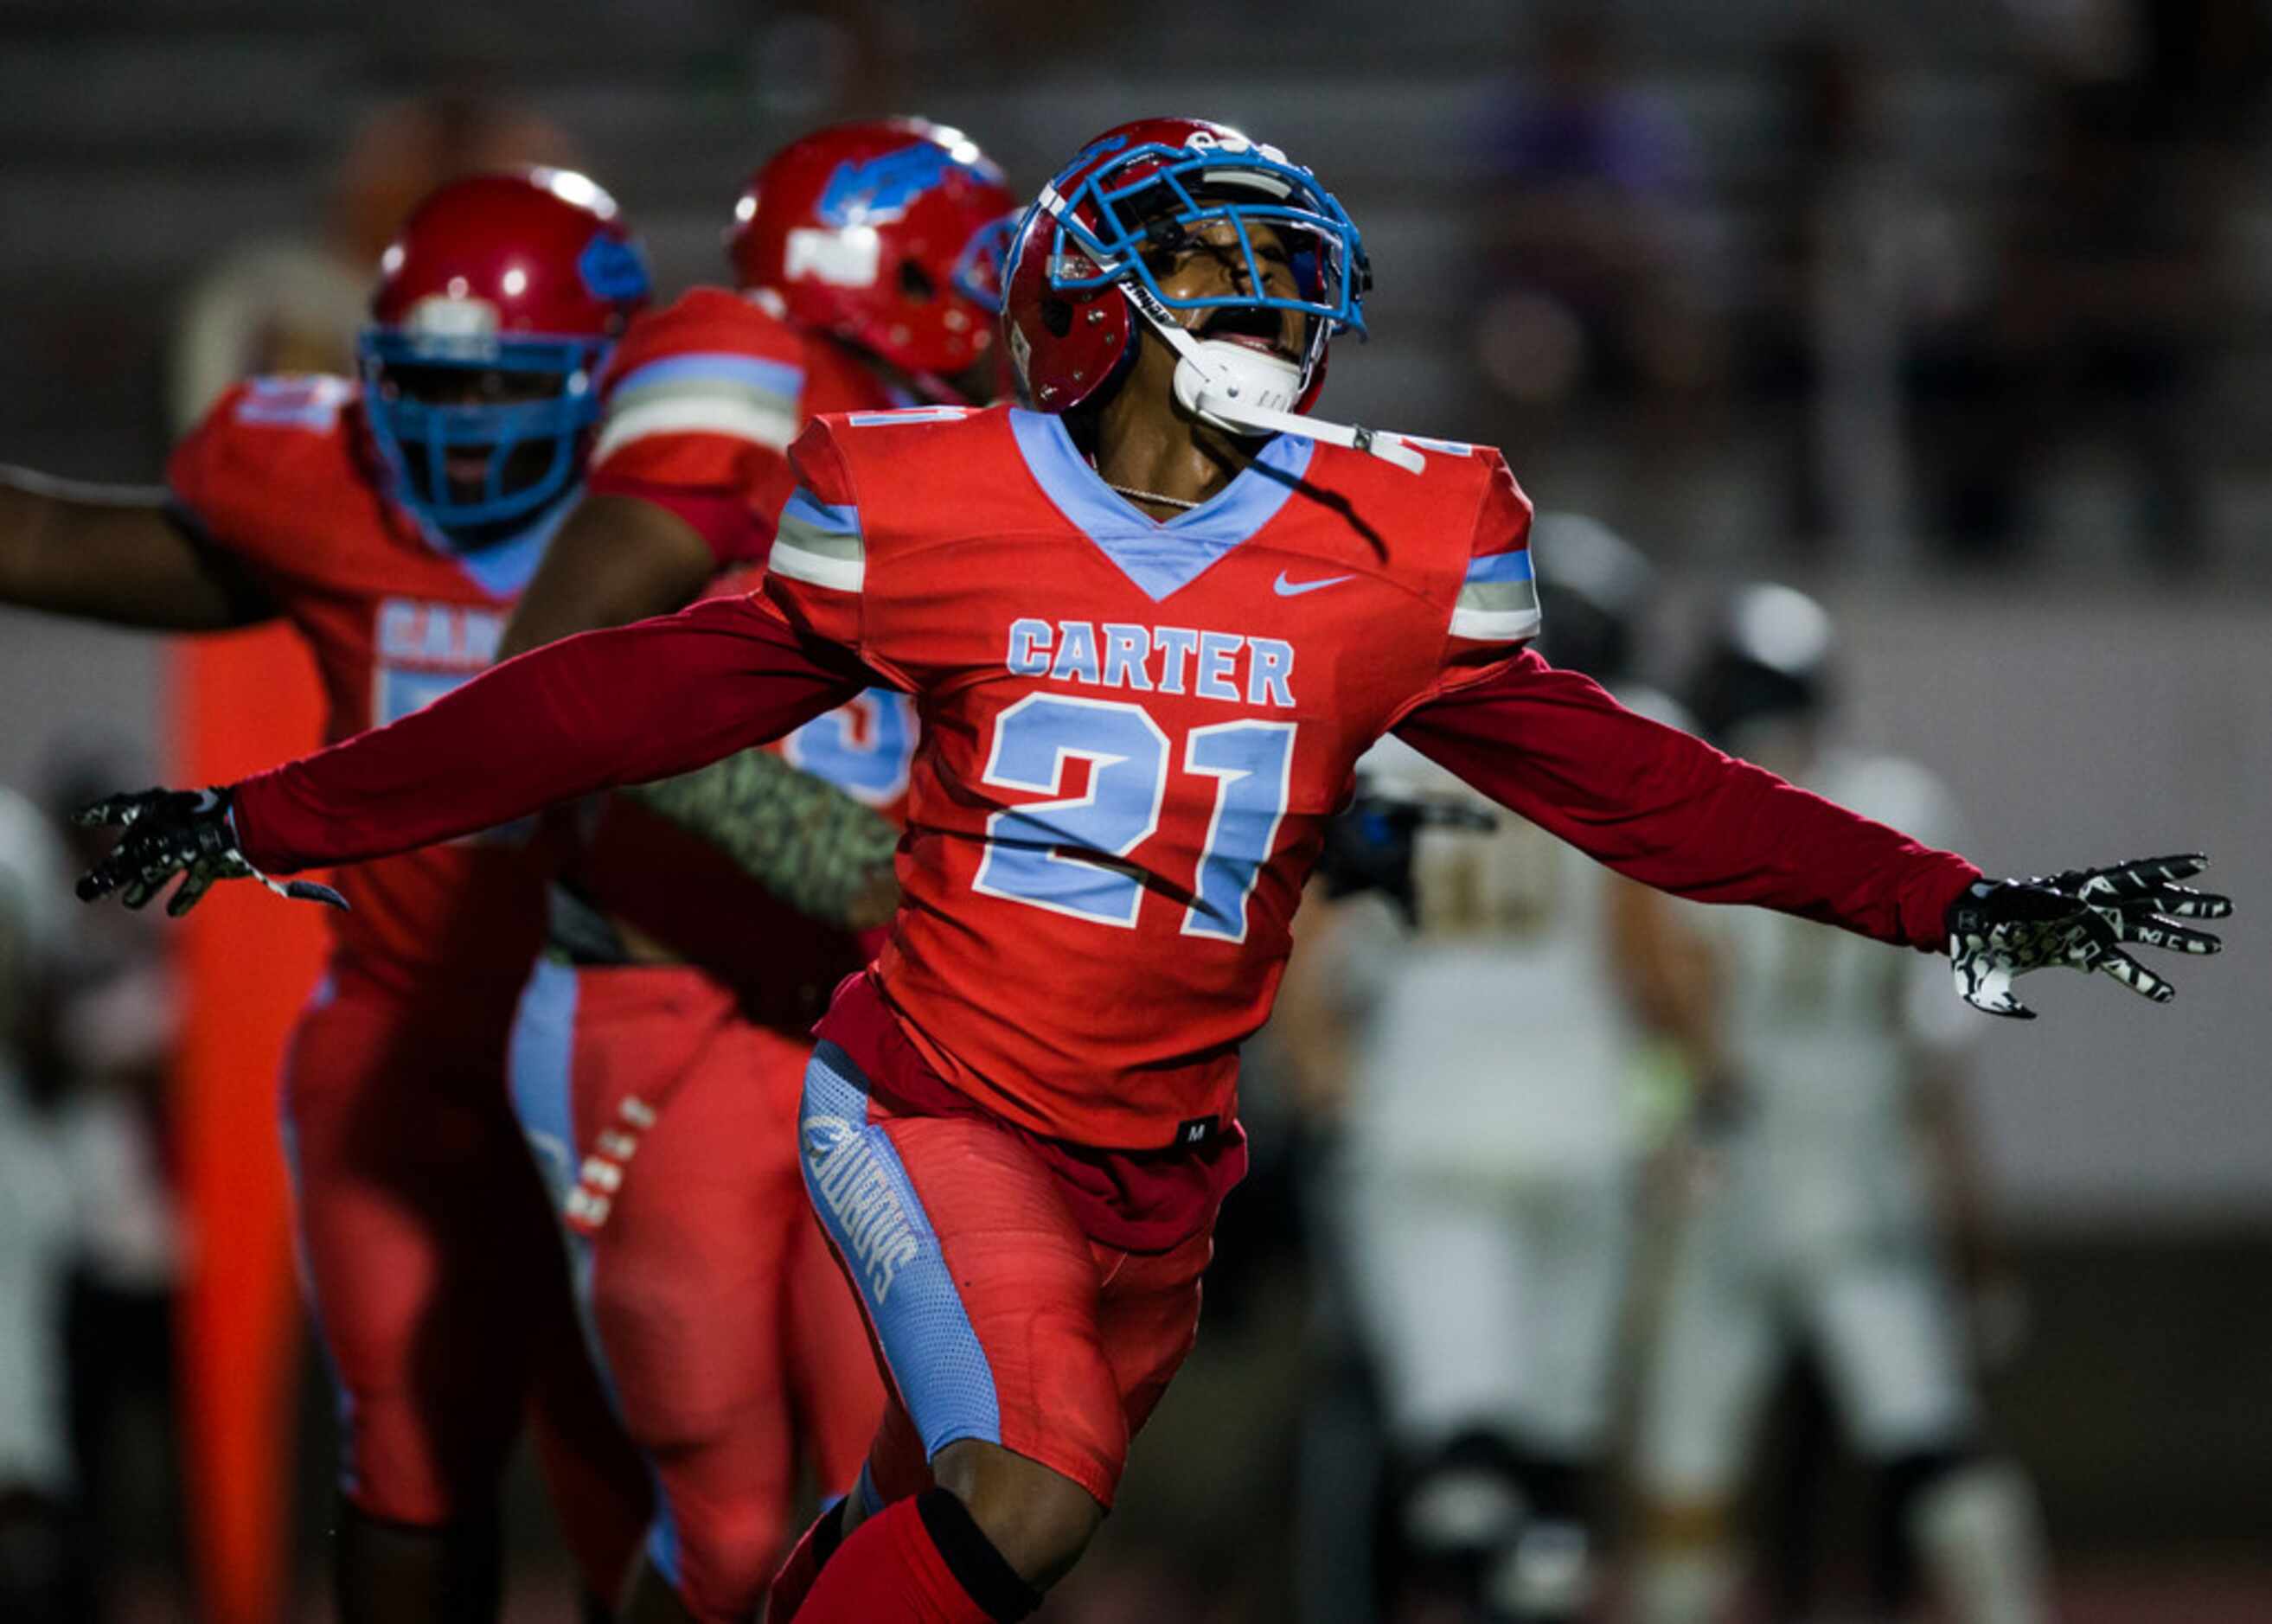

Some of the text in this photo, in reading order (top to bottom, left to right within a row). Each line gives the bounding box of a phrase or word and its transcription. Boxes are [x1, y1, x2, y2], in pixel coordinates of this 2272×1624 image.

[1006, 617, 1296, 707] CARTER
[970, 691, 1299, 944] 21
[1187, 1124, 1206, 1142] M
